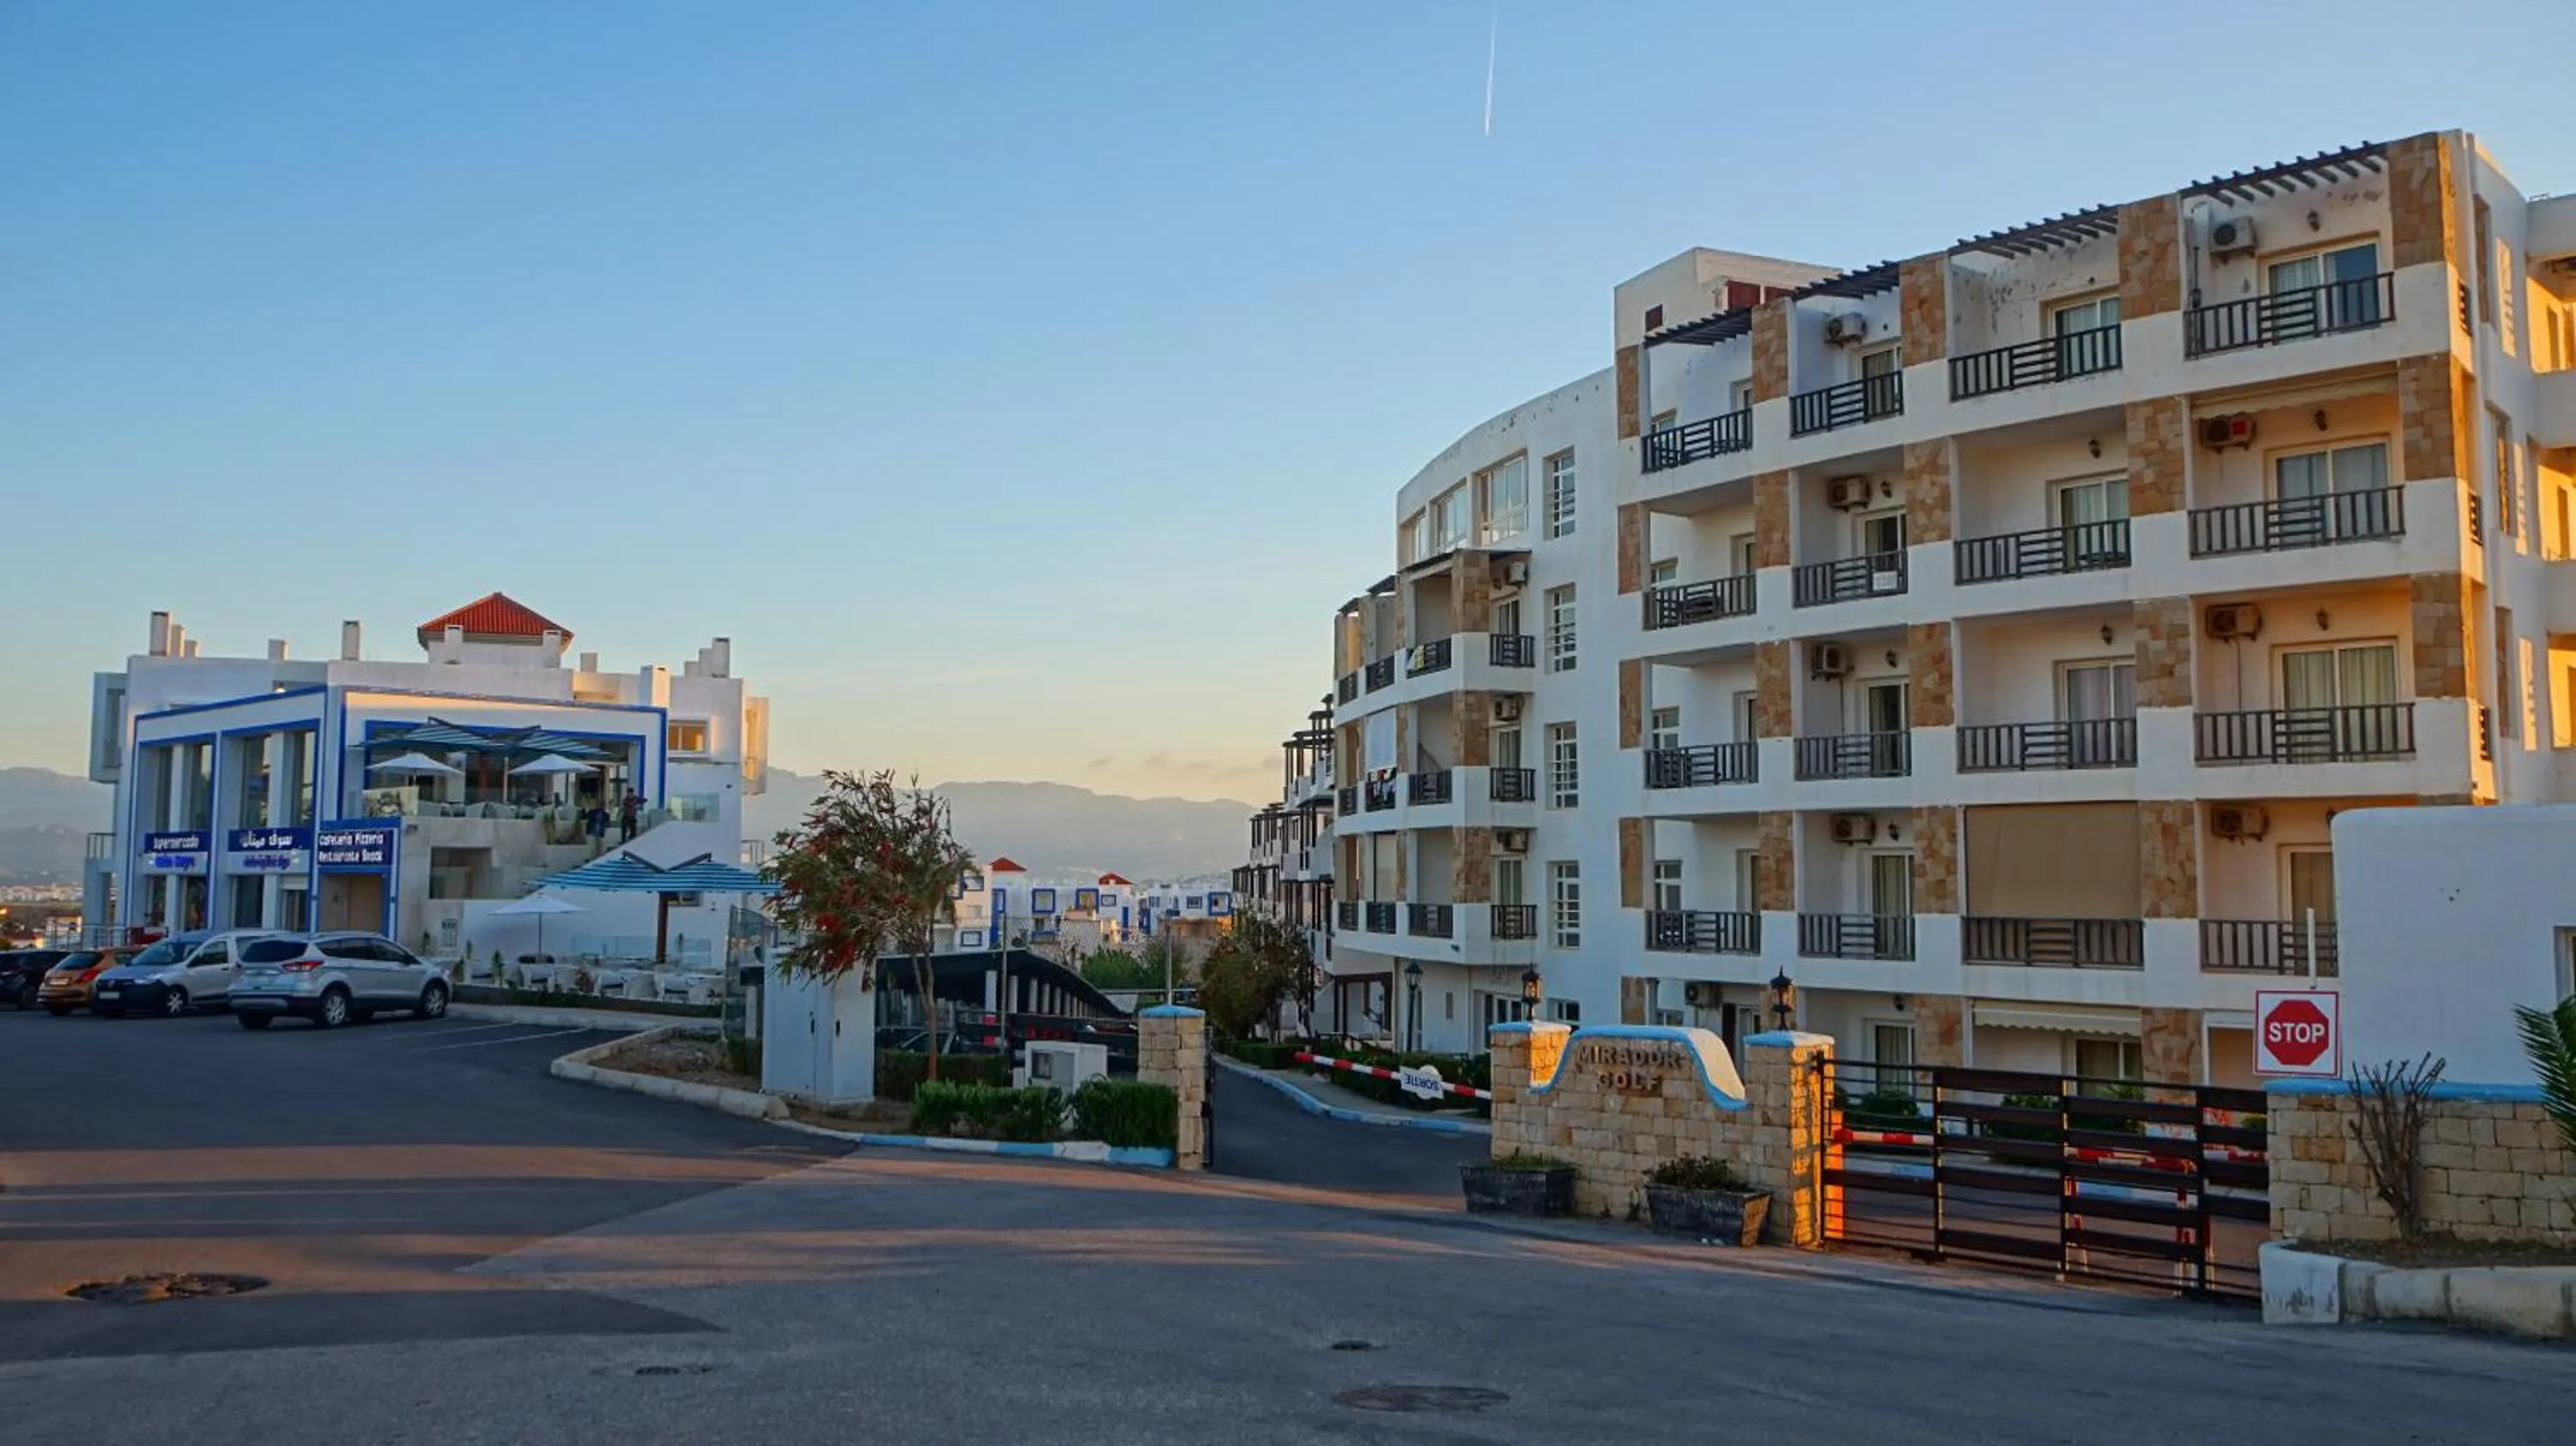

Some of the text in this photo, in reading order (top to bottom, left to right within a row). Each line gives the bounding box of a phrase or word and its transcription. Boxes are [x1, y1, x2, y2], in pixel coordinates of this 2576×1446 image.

[2268, 1021, 2325, 1043] STOP
[1577, 1045, 1682, 1068] MIRADOR
[1404, 1073, 1440, 1091] SORTIE
[1597, 1072, 1658, 1091] GOLF
